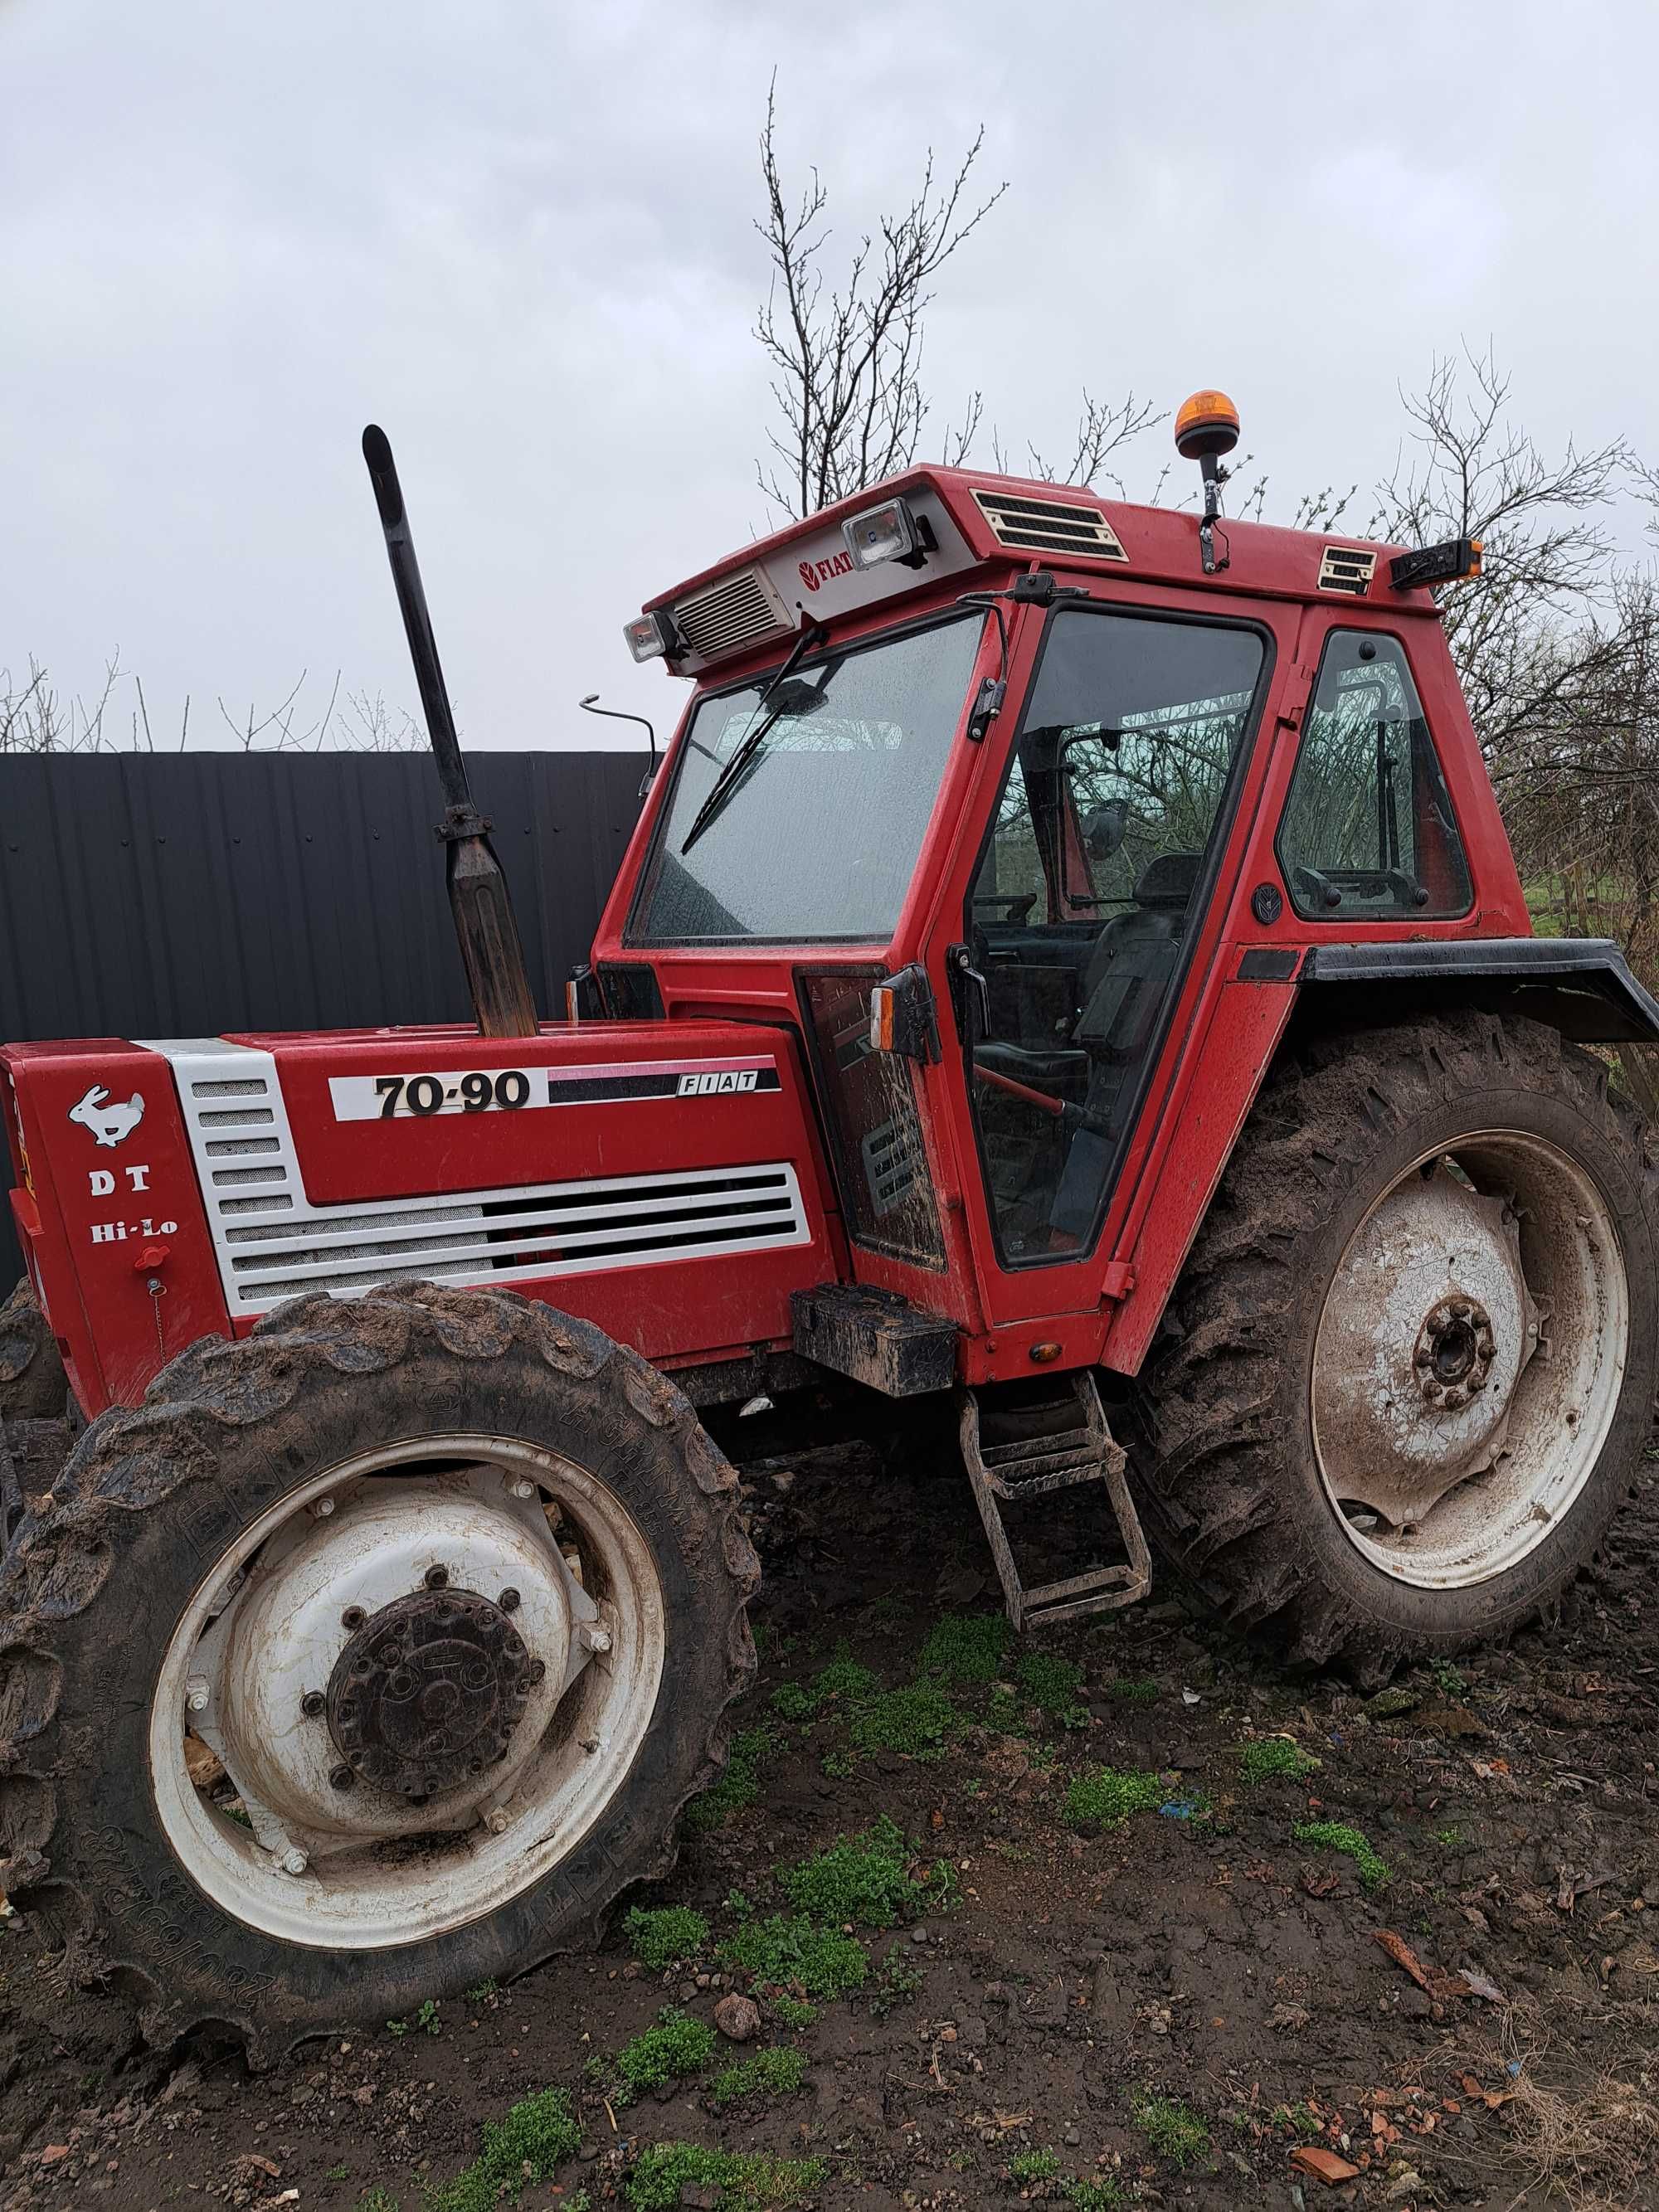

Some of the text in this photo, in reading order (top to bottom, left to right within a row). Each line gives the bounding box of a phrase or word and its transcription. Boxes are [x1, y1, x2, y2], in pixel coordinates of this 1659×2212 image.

[815, 550, 854, 581] FIAT
[376, 1070, 531, 1118] 70-90
[683, 1072, 756, 1094] FIAT
[90, 1218, 178, 1243] Hi-Lo
